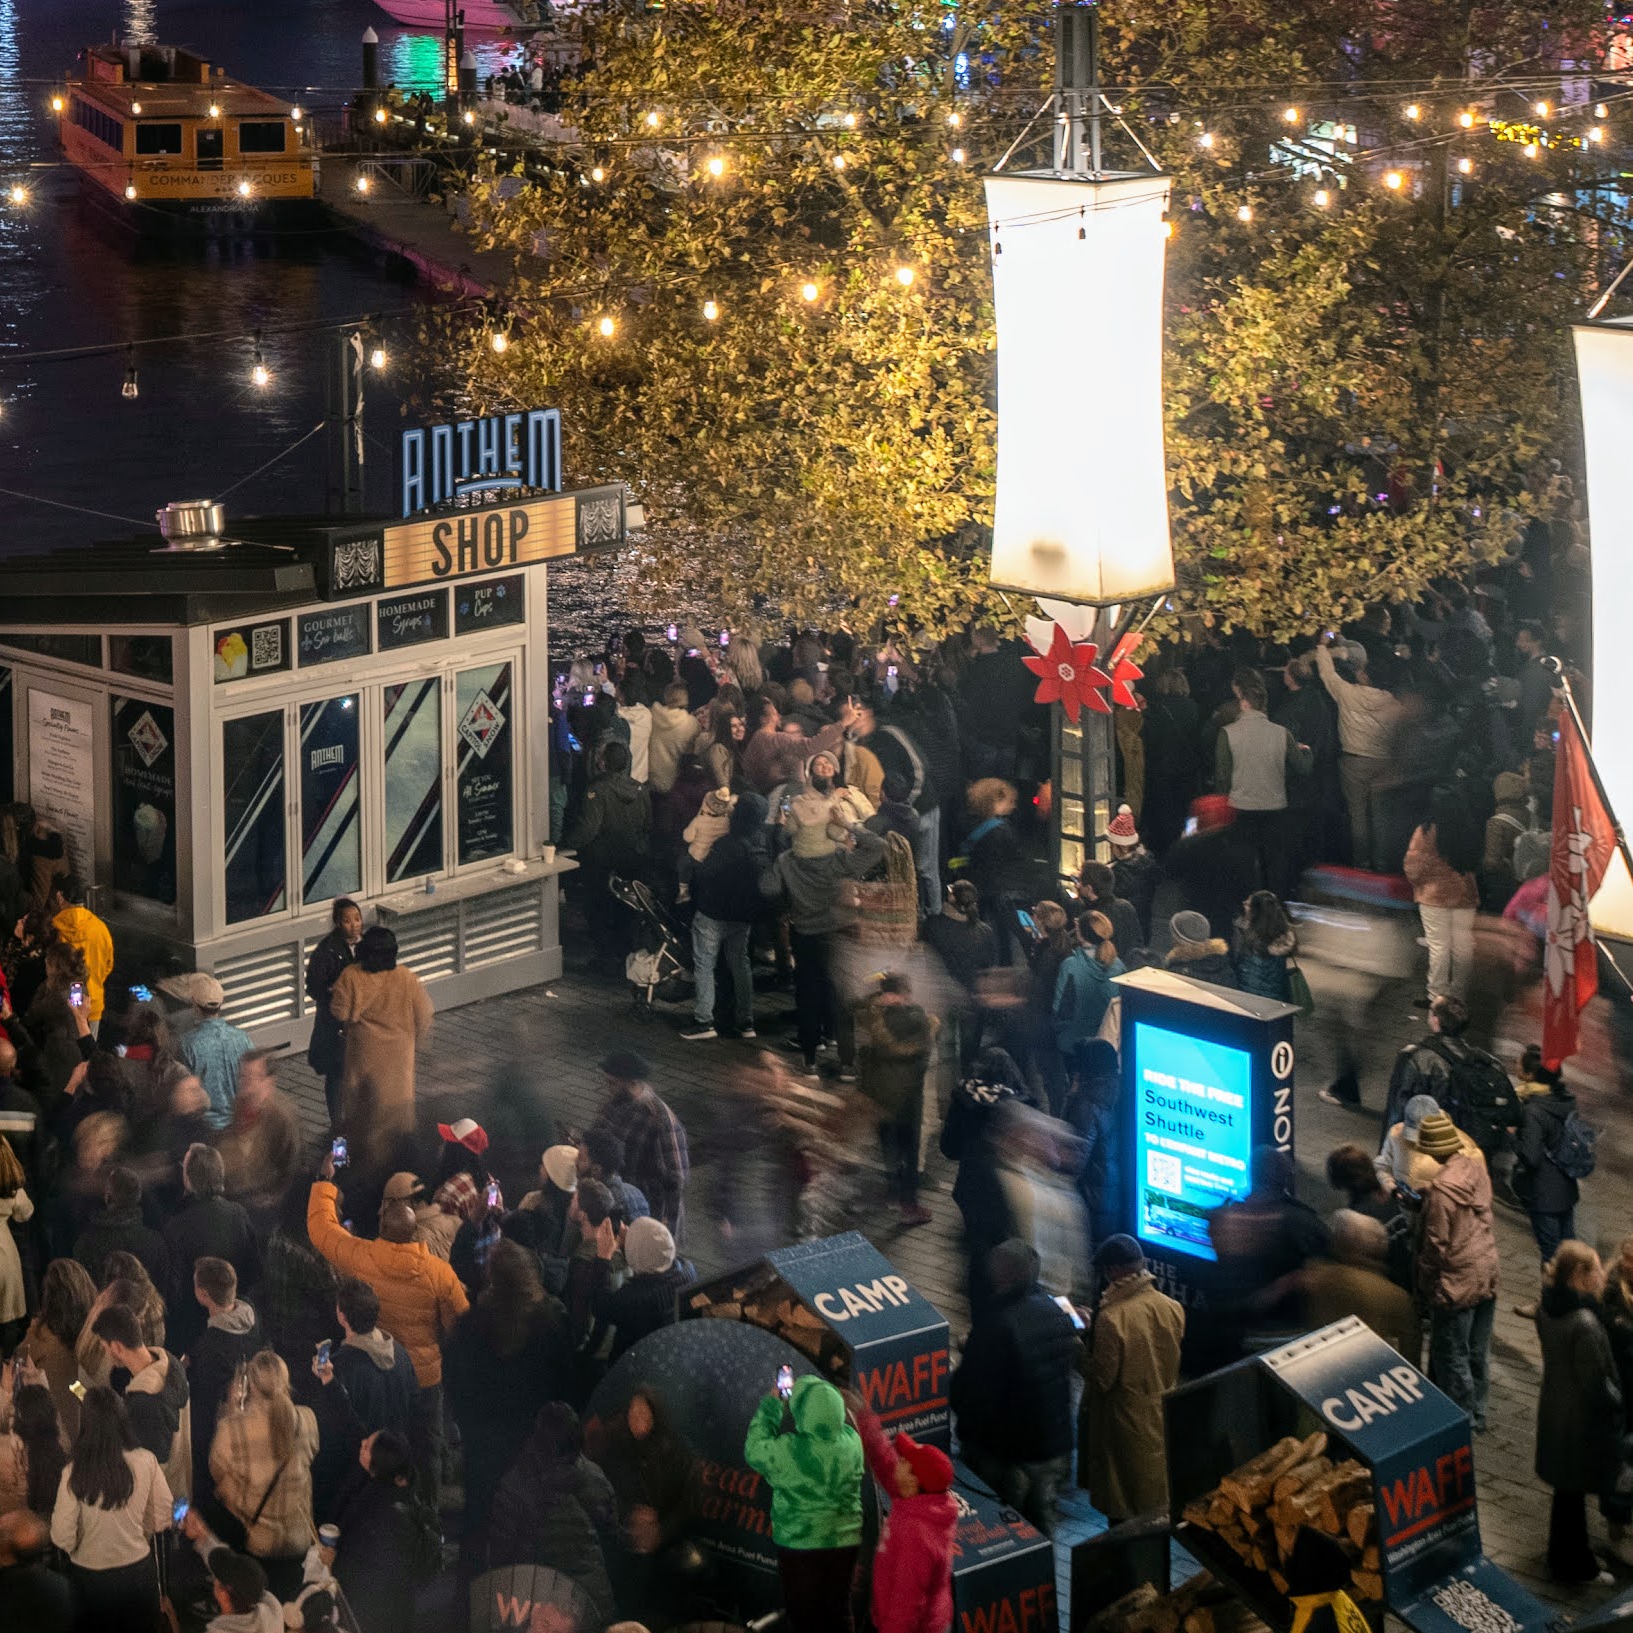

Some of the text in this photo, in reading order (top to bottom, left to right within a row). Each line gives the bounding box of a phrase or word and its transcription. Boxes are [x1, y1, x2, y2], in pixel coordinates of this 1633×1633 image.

[402, 408, 562, 519] ANTHEM
[431, 509, 530, 576] SHOP
[378, 598, 436, 618] HOMEMADE
[474, 587, 493, 600] PUP
[303, 614, 354, 633] GOURMET
[473, 600, 493, 618] Cups
[392, 615, 423, 634] Syrups
[461, 721, 500, 752] CAPITOL SNOW
[310, 744, 344, 771] ANTHEM
[124, 766, 173, 786] HOMEMADE
[1178, 1077, 1206, 1099] THE
[1207, 1085, 1244, 1109] FREE
[1145, 1089, 1234, 1127] Southwest
[1144, 1132, 1160, 1146] TO
[1145, 1111, 1205, 1140] Shuttle
[1143, 1256, 1177, 1280] THE
[813, 1275, 910, 1322] CAMP
[857, 1349, 949, 1411] WAFF
[1321, 1365, 1424, 1432] CAMP
[1381, 1444, 1472, 1526] WAFF
[738, 1546, 756, 1560] Fuel
[757, 1552, 779, 1568] Fund
[960, 1582, 1055, 1633] WAFF
